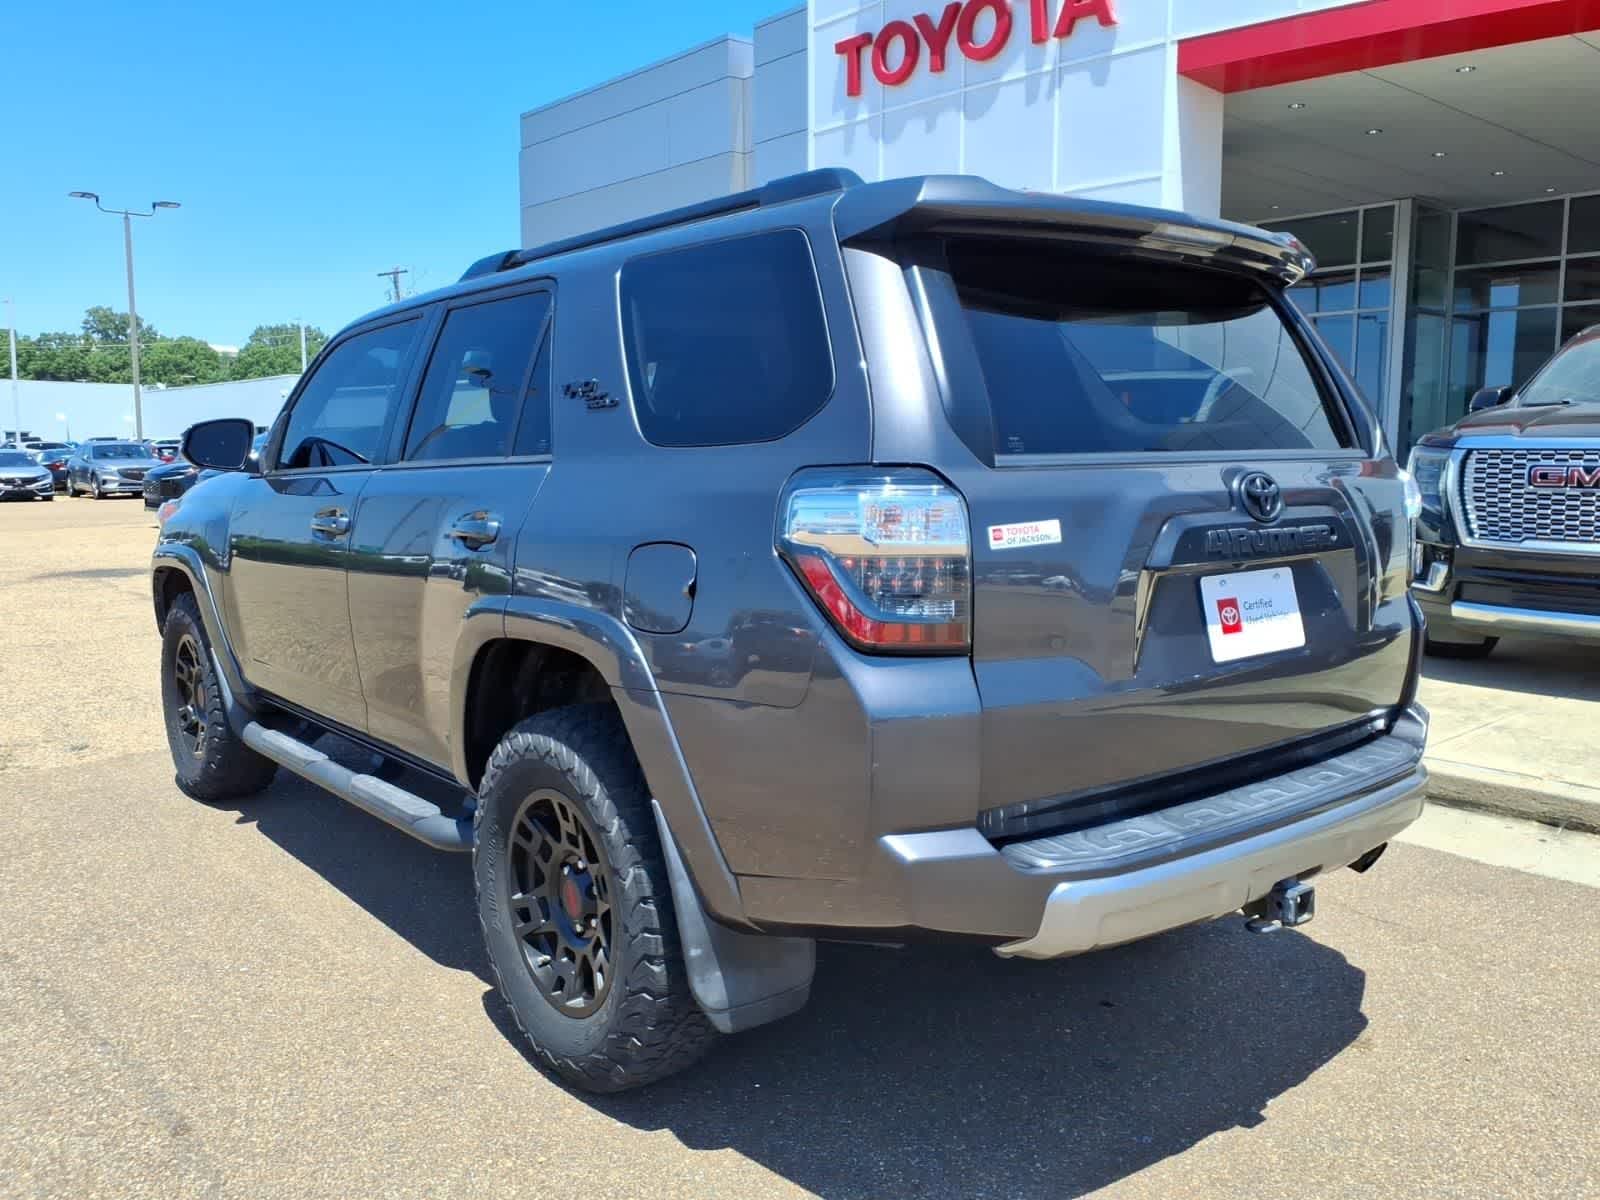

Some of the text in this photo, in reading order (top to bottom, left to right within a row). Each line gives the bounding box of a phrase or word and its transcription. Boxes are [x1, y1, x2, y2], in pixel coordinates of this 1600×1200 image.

[835, 0, 1118, 97] TOYOTA
[1006, 524, 1041, 536] TOYOTA
[1006, 533, 1051, 545] OF JACKSON
[1243, 598, 1274, 611] Certified
